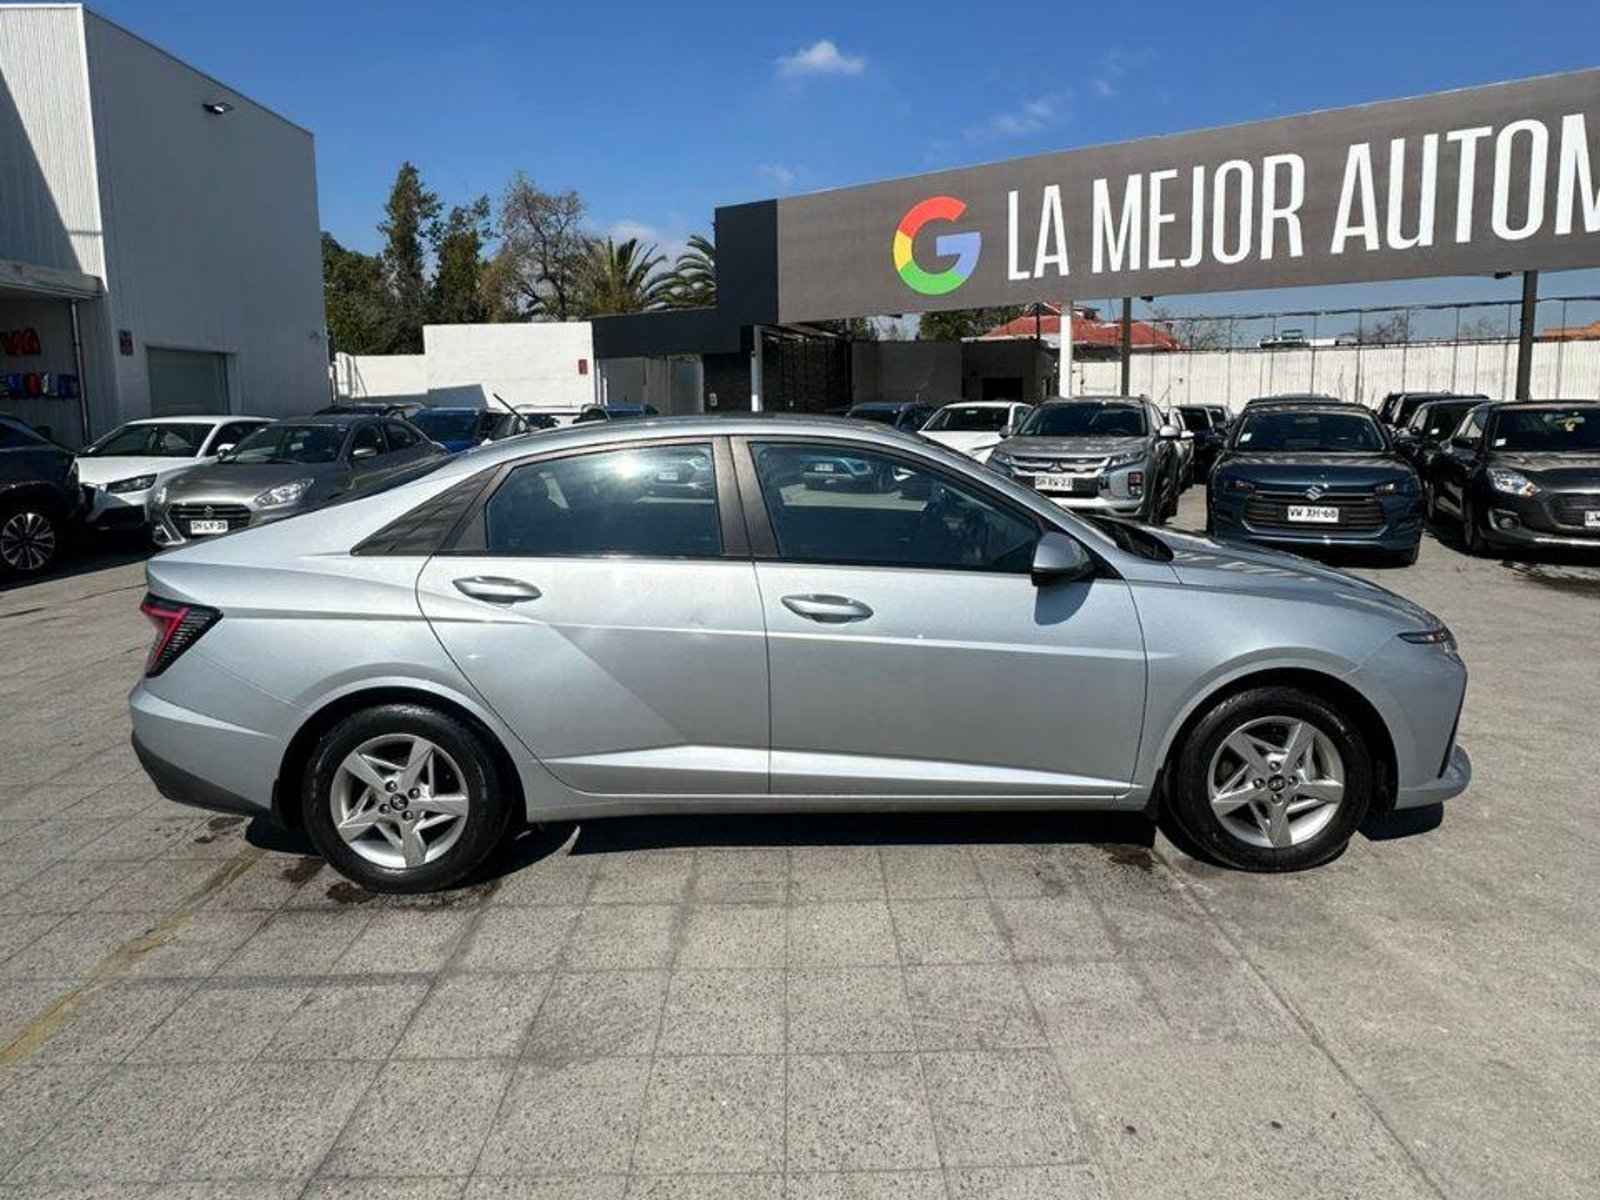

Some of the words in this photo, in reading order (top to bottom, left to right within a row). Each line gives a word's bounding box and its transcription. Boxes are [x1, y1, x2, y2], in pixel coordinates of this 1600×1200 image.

[892, 195, 981, 295] G
[1007, 184, 1069, 281] LA
[1092, 153, 1305, 274] MEJOR
[1330, 113, 1600, 254] AUTOM
